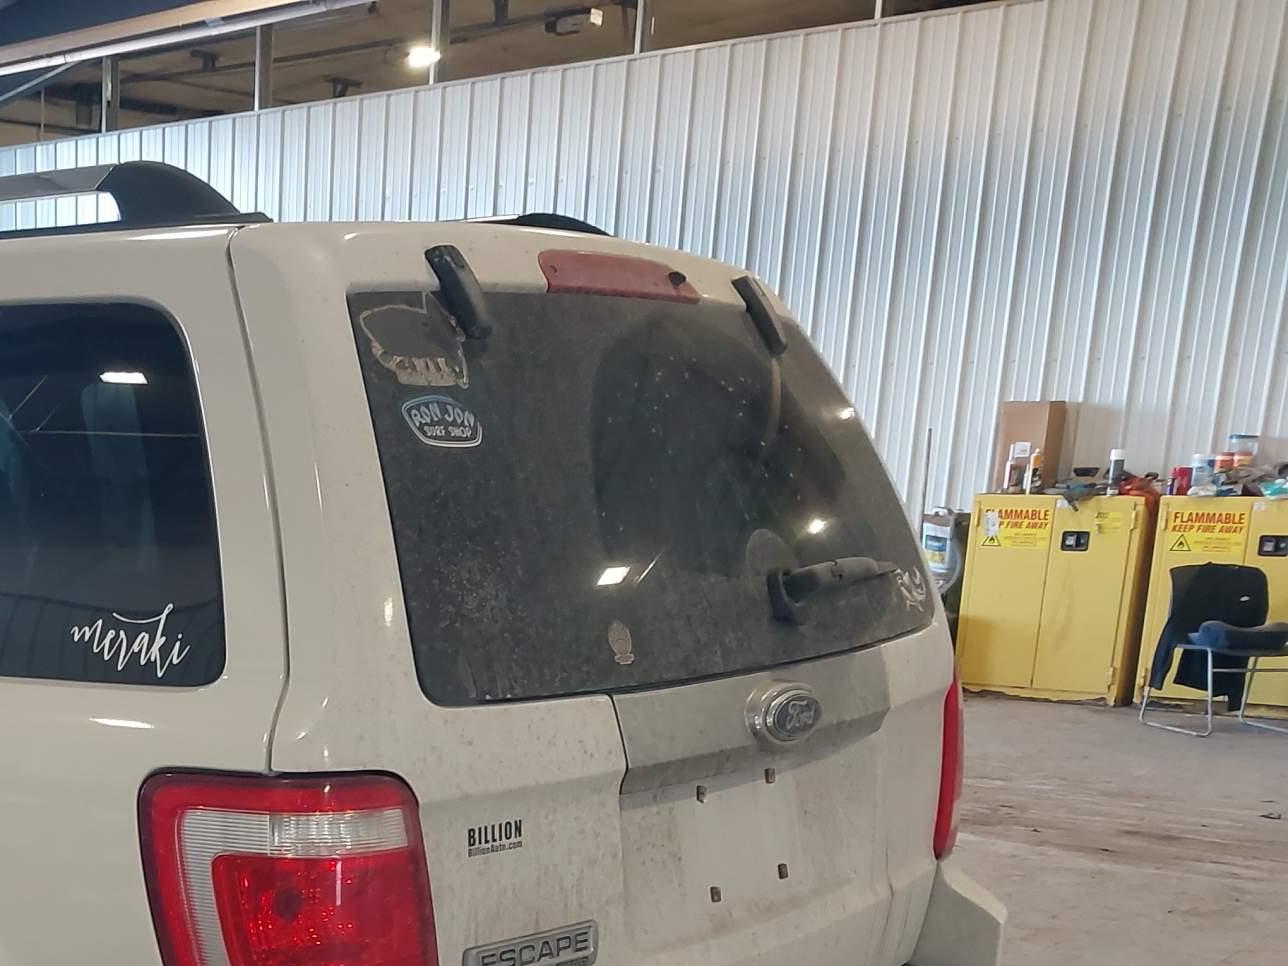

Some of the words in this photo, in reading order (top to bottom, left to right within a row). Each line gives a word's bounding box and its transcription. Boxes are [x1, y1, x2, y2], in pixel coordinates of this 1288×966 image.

[410, 402, 442, 427] RON
[444, 404, 475, 427] JON
[447, 426, 472, 438] SHOP
[985, 508, 1050, 521] AMMABLE
[1173, 511, 1246, 525] FLAMMABLE
[1004, 520, 1024, 529] FIRE
[1025, 521, 1049, 530] AWAY
[1171, 523, 1195, 533] KEEP
[1196, 524, 1217, 534] FIRE
[1218, 525, 1245, 535] AWAY
[69, 603, 191, 678] meraki
[467, 819, 522, 848] BILLION
